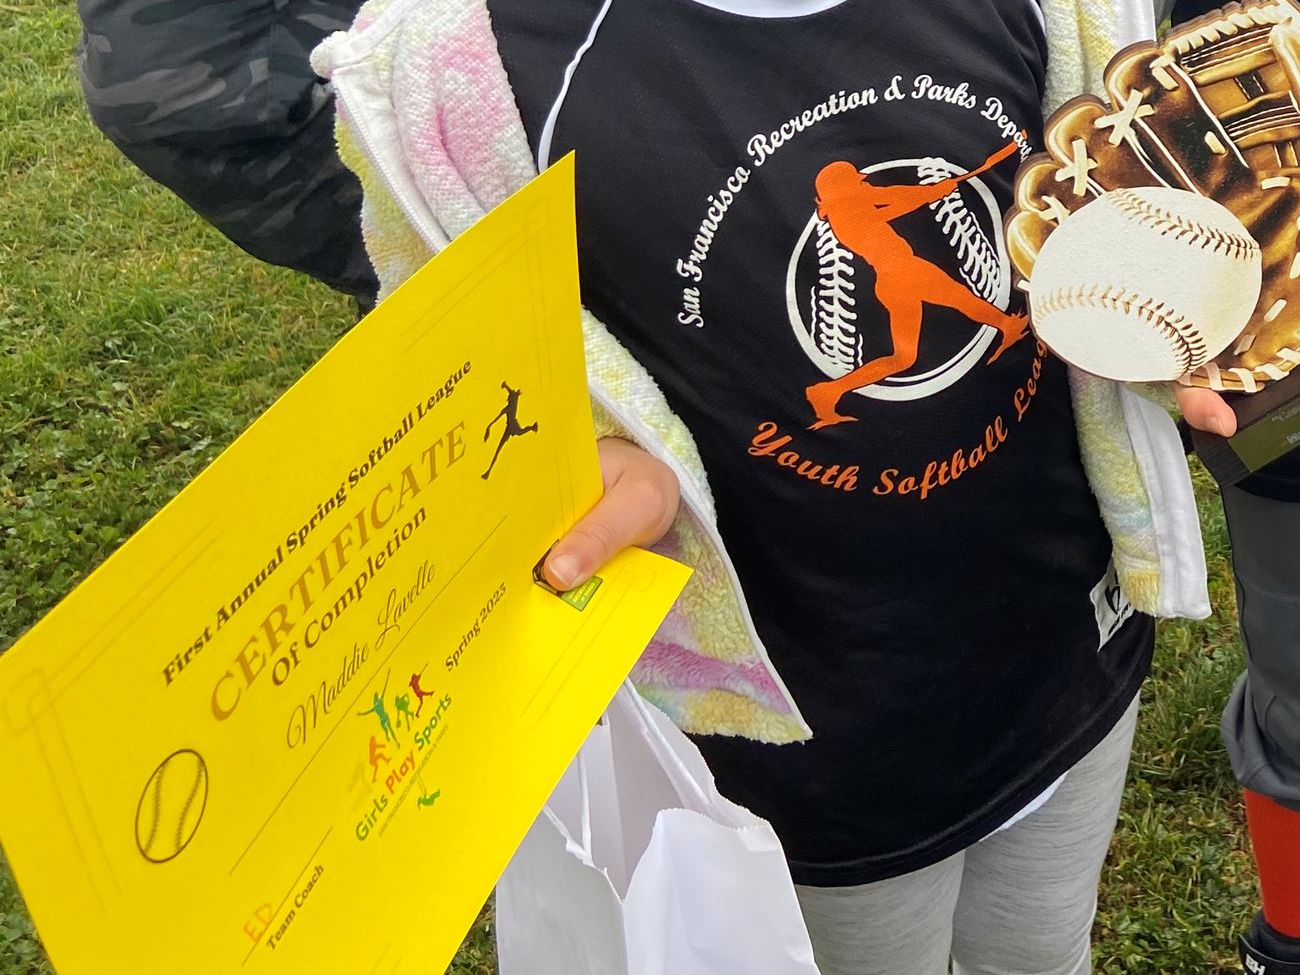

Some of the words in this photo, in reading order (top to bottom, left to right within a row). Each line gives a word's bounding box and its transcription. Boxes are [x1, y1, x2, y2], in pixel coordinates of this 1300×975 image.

[747, 86, 879, 167] Recreation
[884, 74, 906, 101] &
[911, 73, 977, 110] Parks
[980, 96, 1034, 162] Depart
[676, 166, 751, 283] Francisco
[678, 287, 704, 329] San
[747, 421, 860, 492] Youth
[872, 415, 1008, 500] Softball
[1013, 338, 1048, 422] Leag
[161, 627, 213, 687] First
[217, 546, 284, 632] Annual
[287, 482, 347, 554] Spring
[348, 412, 414, 489] Softball
[417, 359, 472, 420] League
[211, 421, 468, 723] CERTIFICATE
[271, 641, 301, 687] Of
[304, 506, 427, 649] Completion
[445, 620, 481, 672] Spring
[287, 643, 369, 749] Maddie
[375, 560, 435, 650] Lavelle
[356, 794, 388, 841] Girls
[385, 750, 415, 794] Play
[414, 693, 452, 751] Sports
[267, 910, 296, 950] Team
[295, 865, 324, 908] Coach
